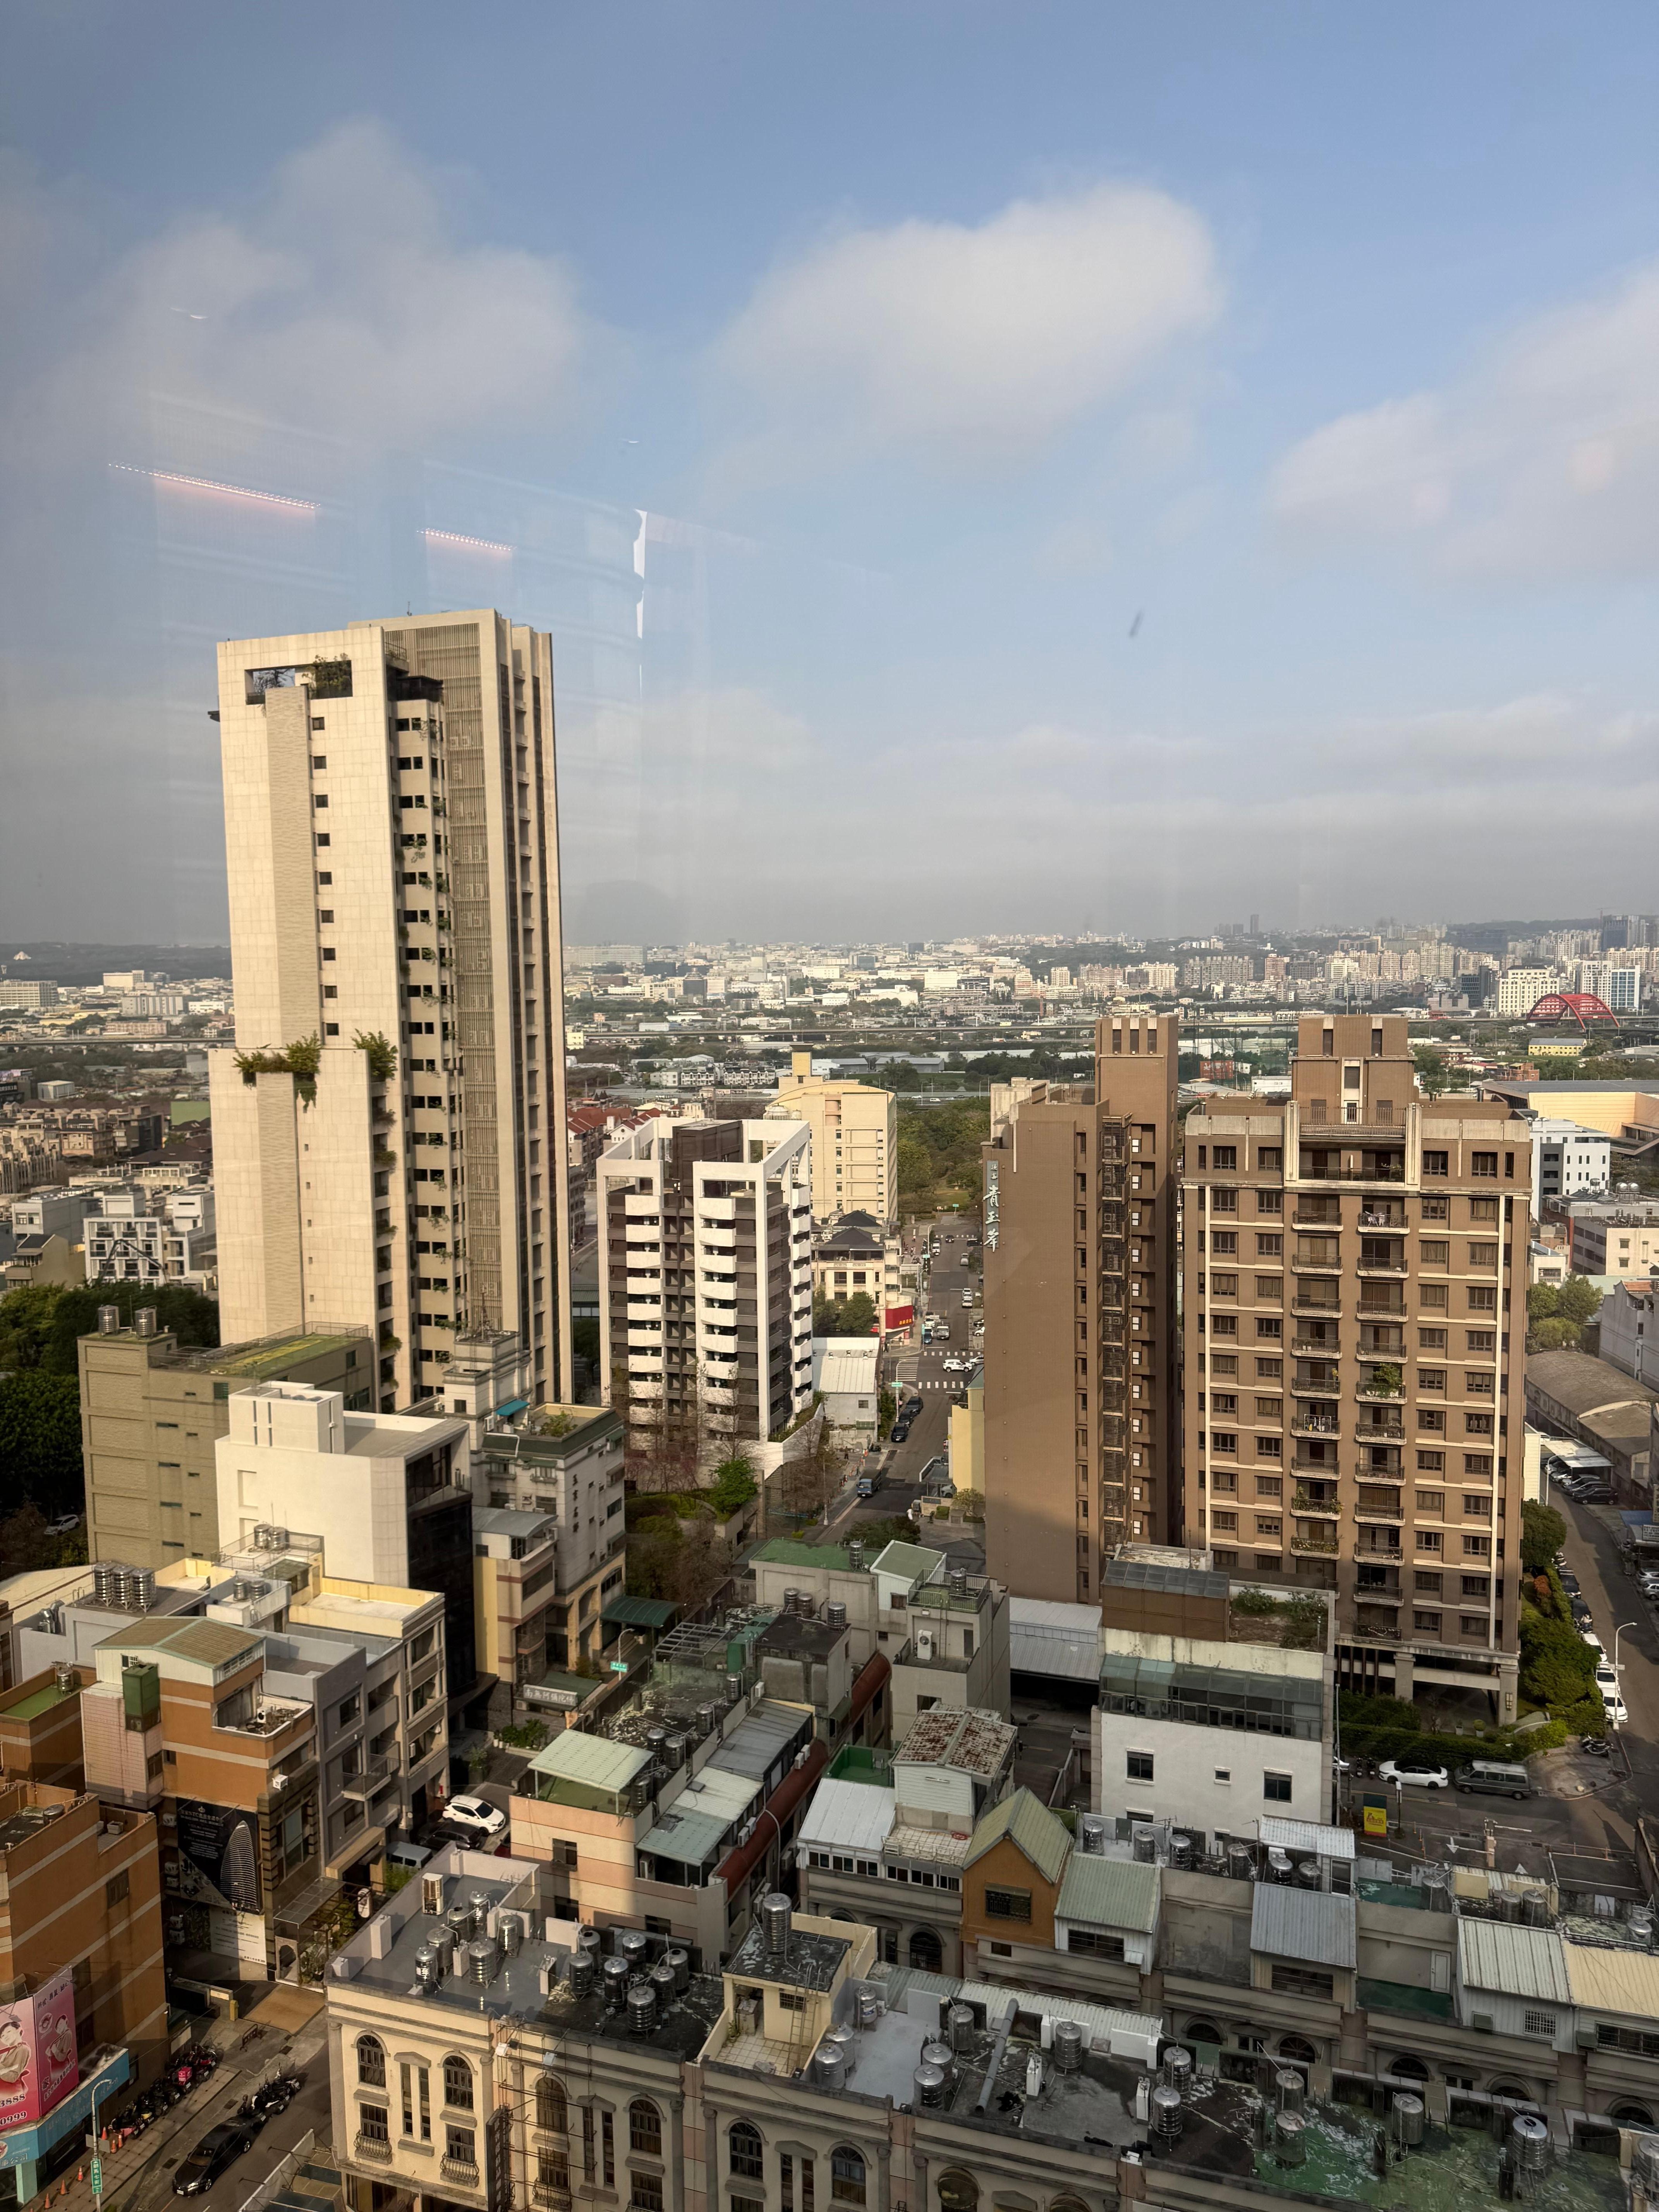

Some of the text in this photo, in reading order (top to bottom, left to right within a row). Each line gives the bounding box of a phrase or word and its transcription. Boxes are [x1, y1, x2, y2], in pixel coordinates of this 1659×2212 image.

[983, 1185, 1001, 1252] 青玉岸
[526, 1688, 574, 1705] 南無阿彌陀佛
[0, 2094, 25, 2107] 3888
[0, 2111, 27, 2125] 0999
